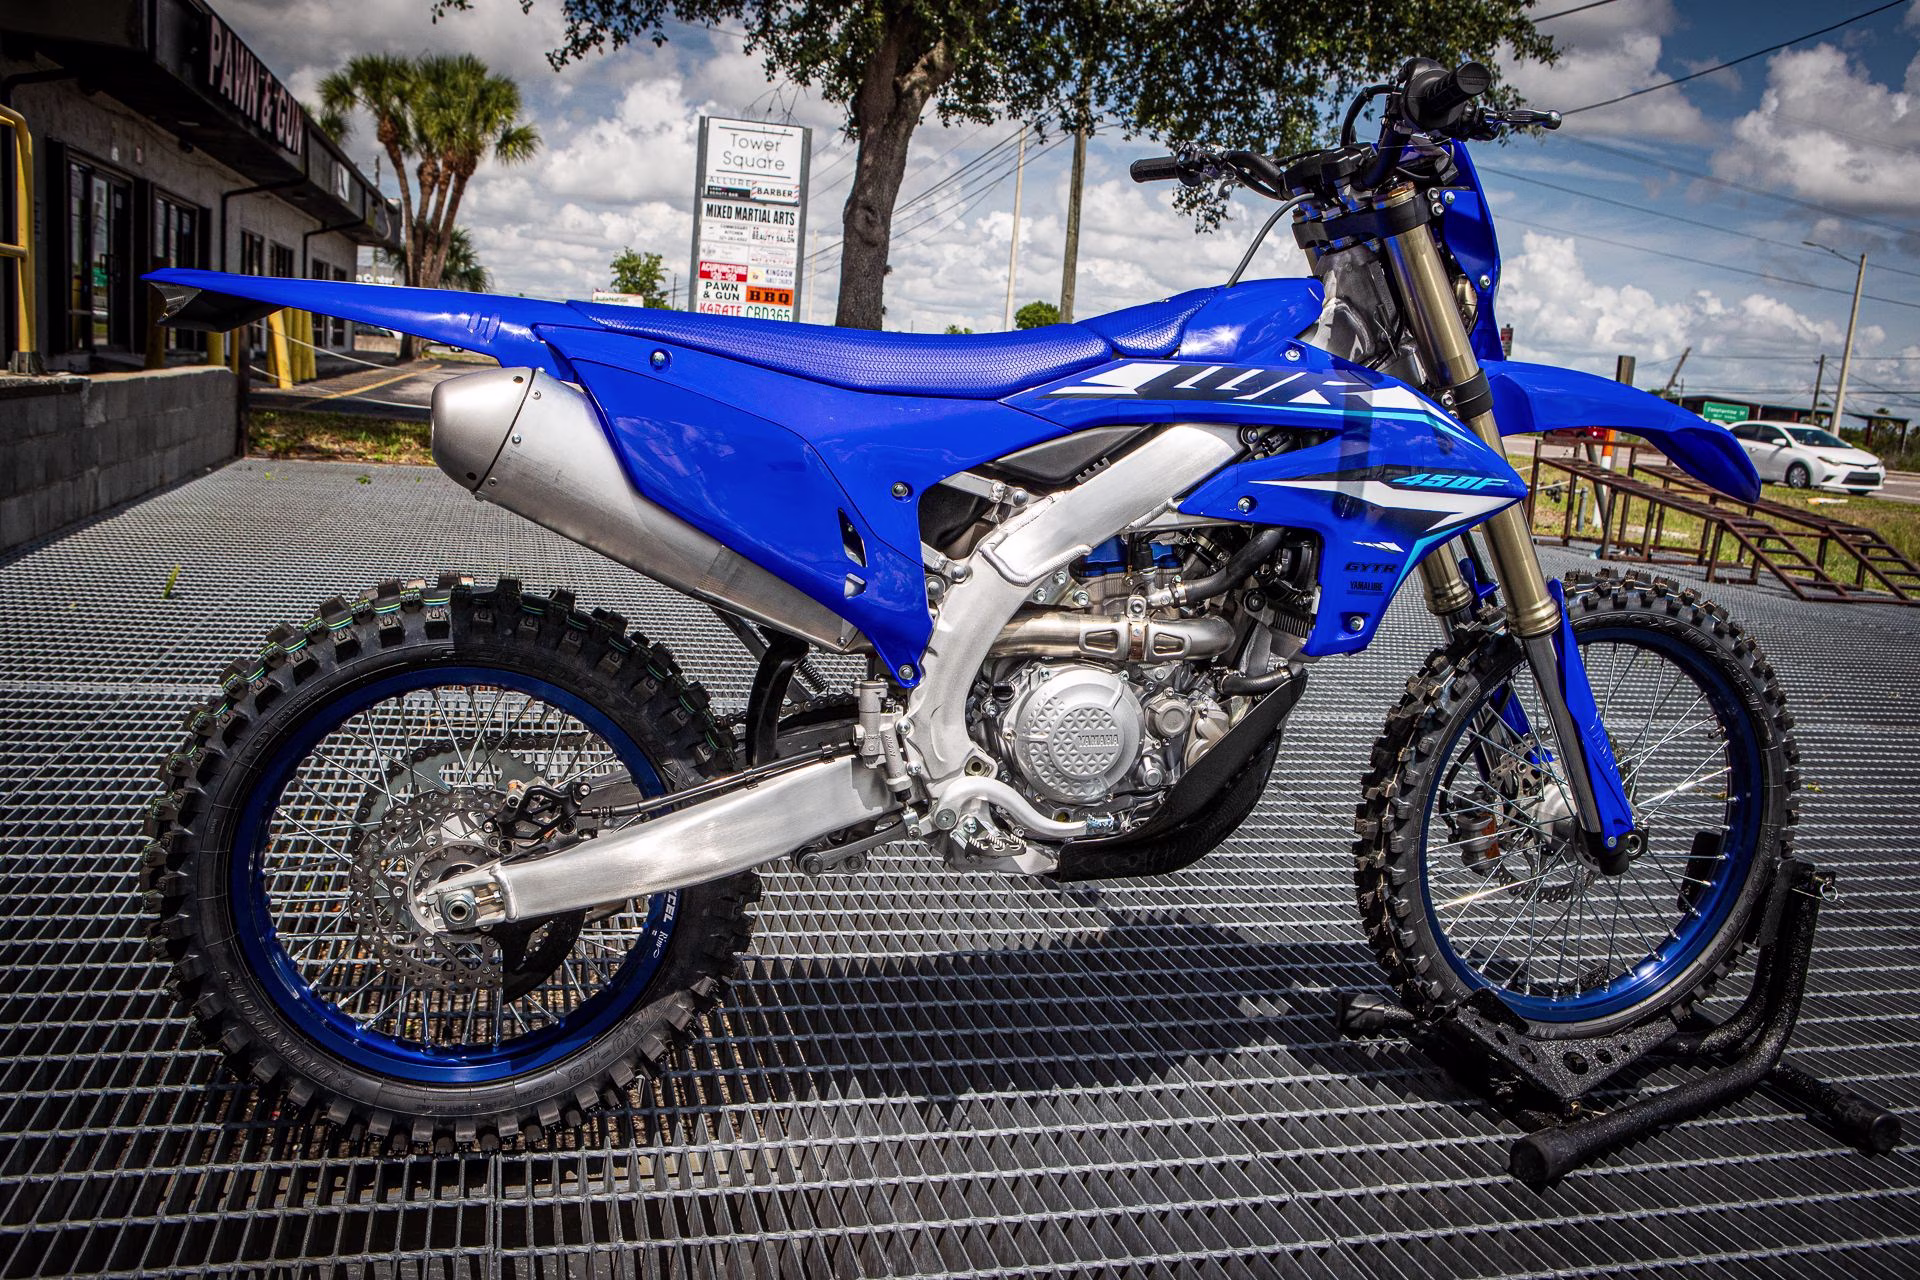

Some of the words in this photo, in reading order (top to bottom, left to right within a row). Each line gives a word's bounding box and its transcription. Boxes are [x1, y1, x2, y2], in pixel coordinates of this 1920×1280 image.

[209, 15, 260, 122] PAWN
[261, 72, 273, 133] &
[276, 86, 304, 156] GUN
[730, 133, 782, 152] Tower
[722, 150, 785, 171] Square
[708, 175, 751, 187] ALLURE
[757, 187, 793, 198] BARBER
[705, 203, 733, 219] MIXED
[735, 206, 771, 223] MARTIAL
[773, 210, 795, 226] ARTS
[752, 231, 774, 241] BEAUTY
[776, 235, 795, 244] SALON
[705, 281, 739, 292] PAWN
[703, 290, 710, 299] &
[715, 291, 740, 301] GUN
[749, 289, 790, 305] BBQ
[699, 302, 742, 319] KARATE
[746, 305, 791, 323] CBD365
[1391, 473, 1510, 491] 450F
[1343, 561, 1397, 574] GYTR
[1350, 580, 1384, 592] YAMALUBE
[1077, 734, 1119, 748] YAMAHA
